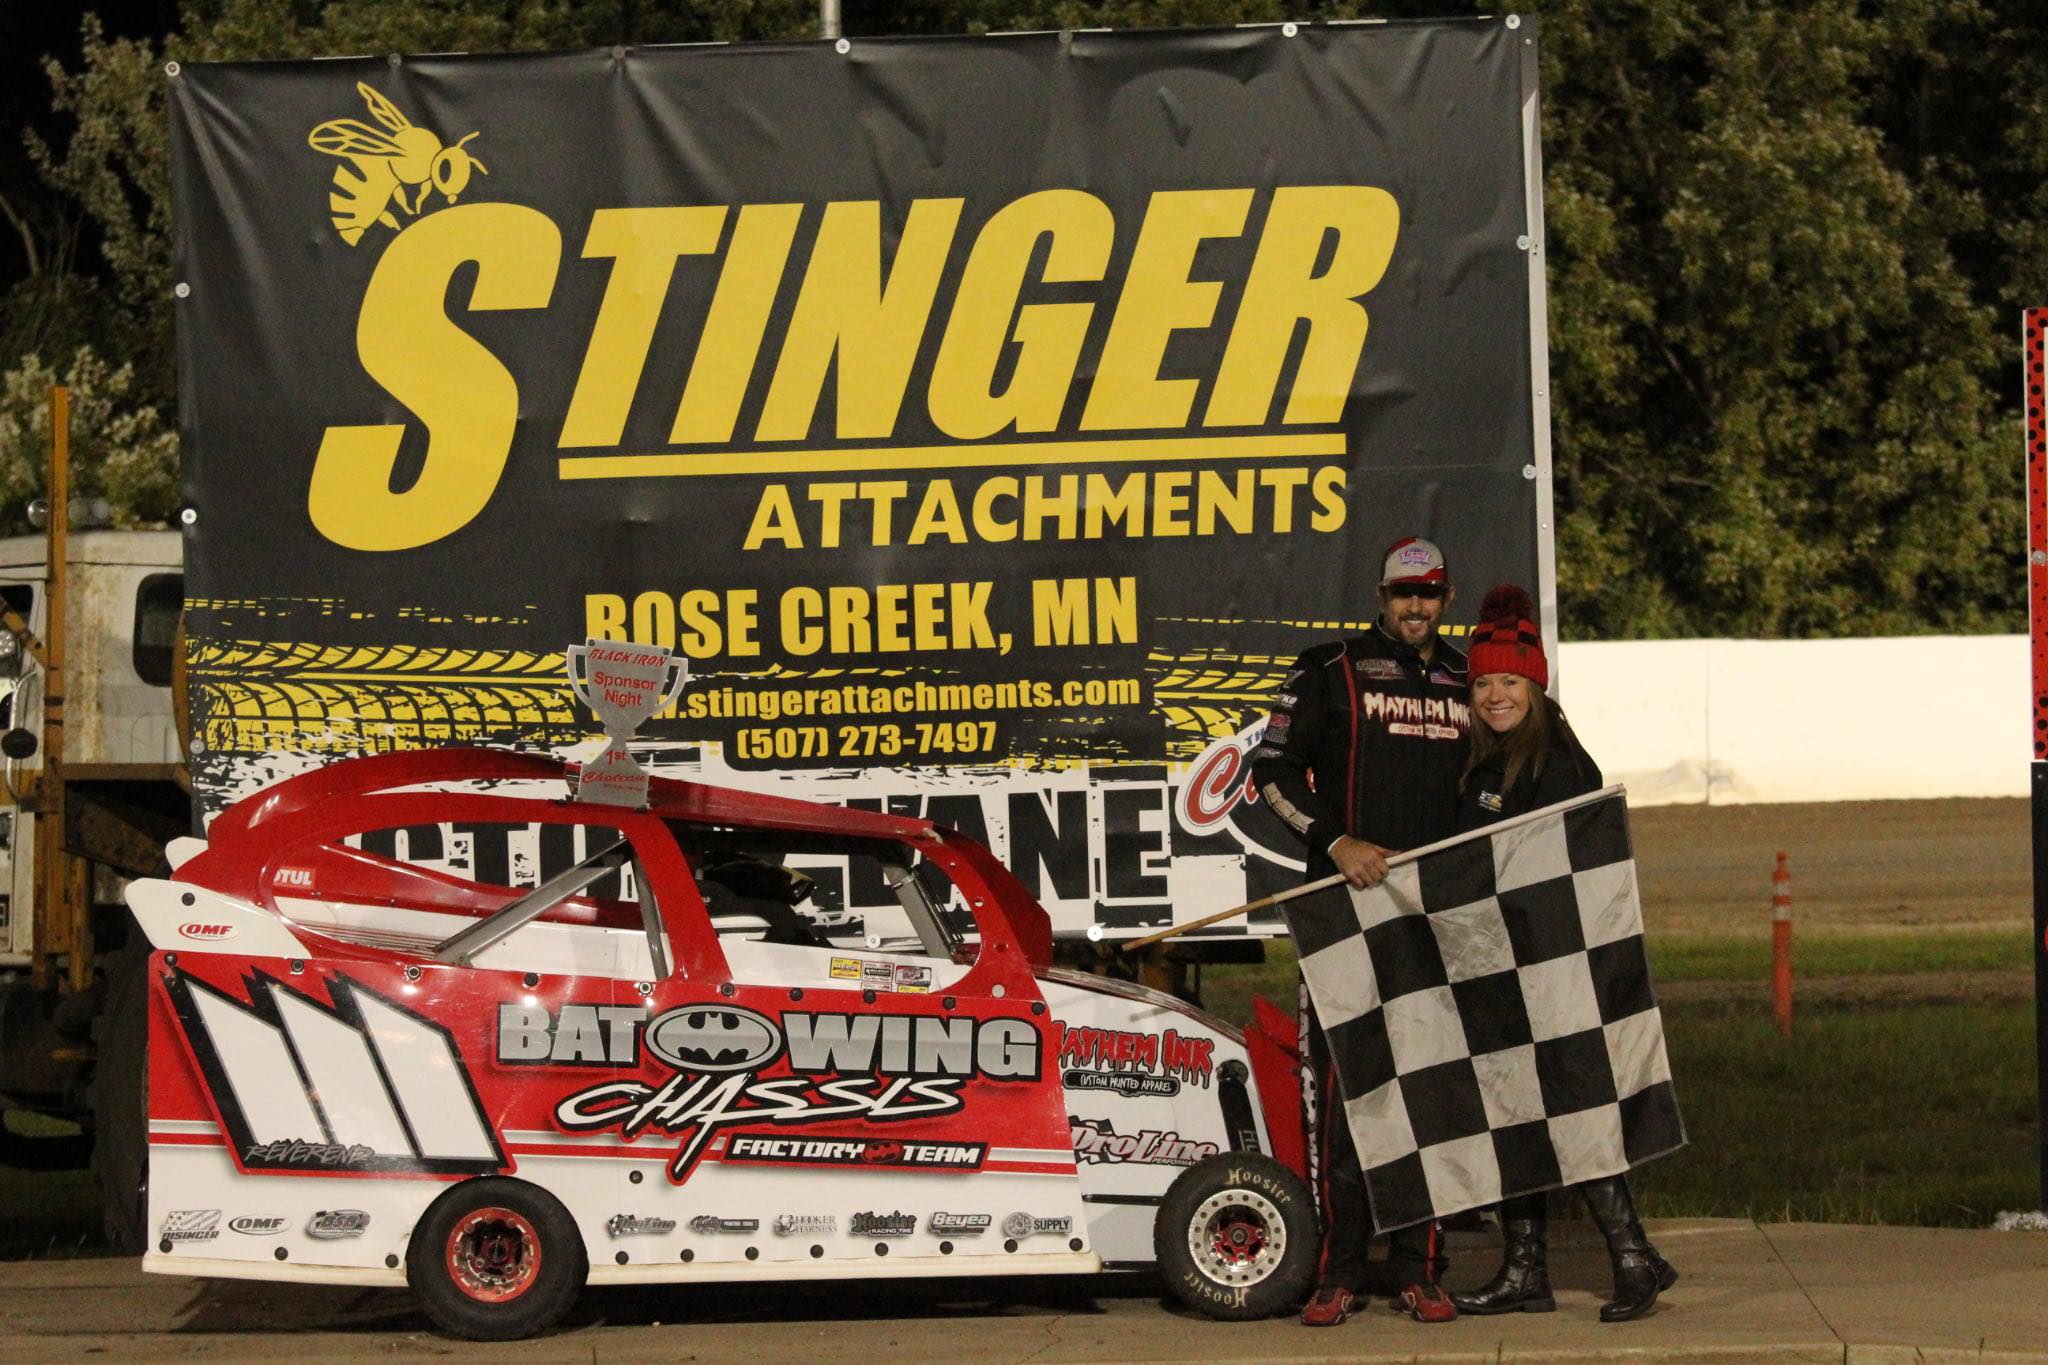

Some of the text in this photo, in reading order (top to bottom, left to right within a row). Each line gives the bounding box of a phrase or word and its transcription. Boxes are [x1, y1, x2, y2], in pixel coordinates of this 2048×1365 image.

[307, 185, 1401, 552] STINGER
[742, 465, 1347, 551] ATTACHMENTS
[585, 577, 1138, 659] ROSE CREEK, MN
[588, 647, 668, 668] BLACK IRON
[594, 671, 657, 692] Sponsor
[592, 678, 1141, 723] w.stingerattachments.com
[604, 689, 643, 709] Night
[736, 721, 997, 760] (507) 273-7497
[606, 750, 627, 767] 1st
[186, 923, 233, 935] OMF
[497, 1004, 1040, 1078] BAT WING
[1162, 1028, 1215, 1090] INK
[1080, 1074, 1172, 1093] CUSTOM PRINTED APPAREL
[556, 1073, 962, 1173] CHASSIS
[731, 1140, 980, 1164] FACTORY TEAM
[236, 1218, 285, 1229] OMF
[795, 1216, 837, 1225] HOOKER
[795, 1225, 838, 1233] HARNESS
[933, 1213, 990, 1228] Beyea
[1033, 1219, 1070, 1230] SUPPLY
